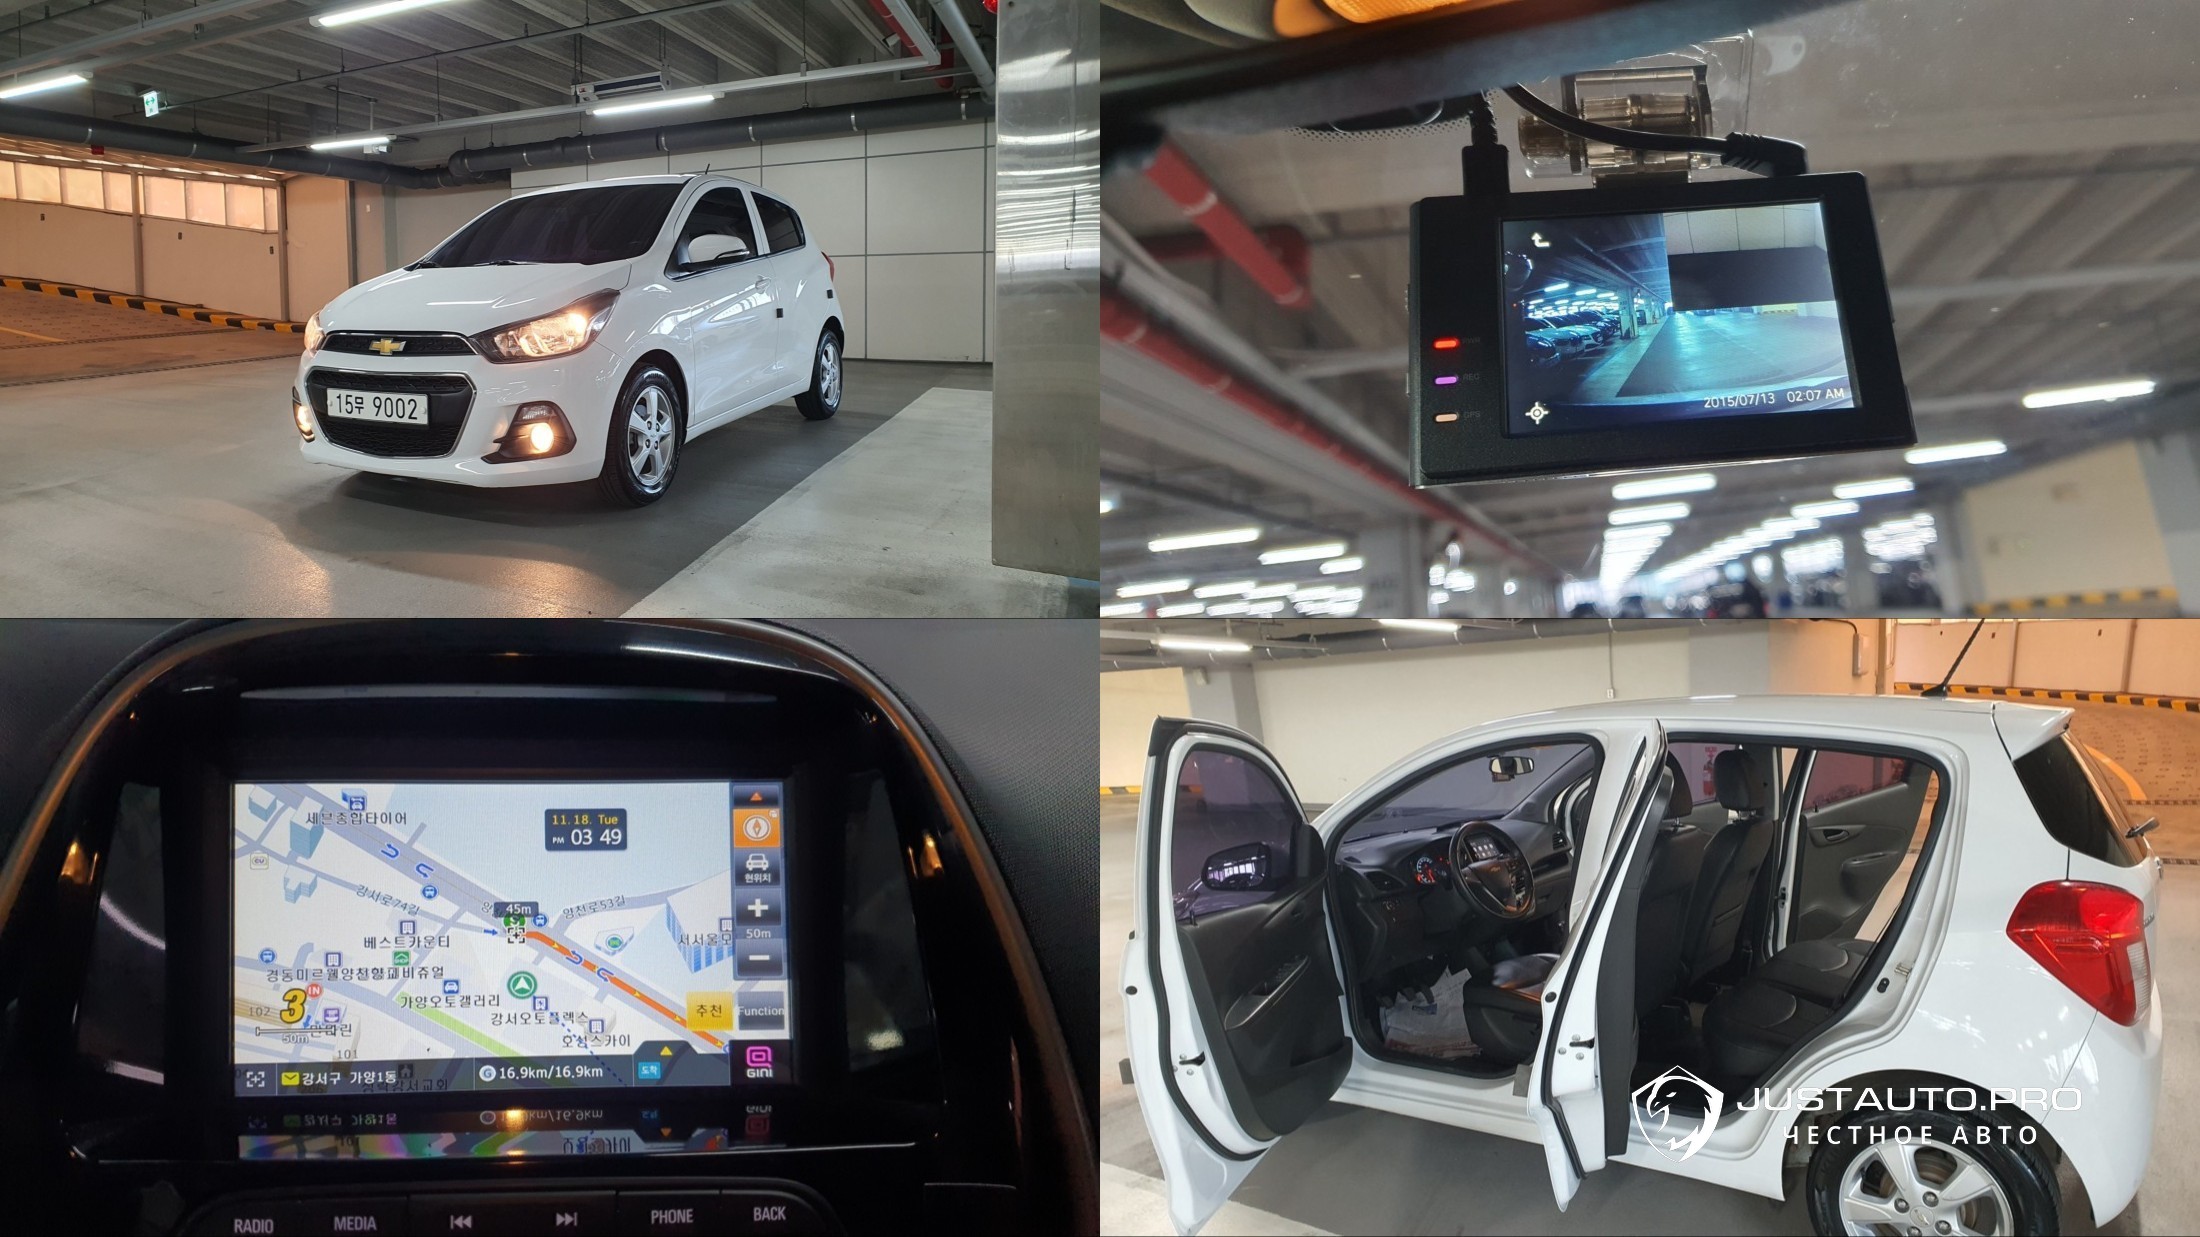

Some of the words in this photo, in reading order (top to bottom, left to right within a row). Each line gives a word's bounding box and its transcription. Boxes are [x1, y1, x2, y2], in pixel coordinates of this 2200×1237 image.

[1703, 393, 1776, 409] 2015/07/13
[1786, 390, 1821, 404] 02:07
[1825, 387, 1845, 400] AM
[373, 396, 418, 420] 9002
[598, 814, 618, 825] Tue
[570, 829, 593, 845] 03
[599, 829, 622, 845] 49
[744, 873, 771, 884] 현위치
[356, 884, 420, 916] 강서로74길
[562, 895, 626, 920] 양천로53길
[506, 903, 532, 915] 45m
[746, 928, 771, 939] 50m
[364, 936, 450, 949] 베스트카운티
[307, 985, 320, 996] IN
[280, 988, 307, 1024] 3
[401, 994, 501, 1009] 가양오토갤러리
[248, 1007, 271, 1017] 102
[696, 1003, 723, 1018] 추천
[739, 1006, 785, 1016] Function
[491, 1011, 589, 1026] 강서오토플렉스
[282, 1034, 309, 1044] 50m
[302, 1073, 341, 1085] 강서구
[350, 1071, 397, 1084] 가양1동
[640, 1065, 658, 1076] 도착
[650, 1209, 694, 1225] PHONE
[753, 1206, 786, 1221] BACK
[233, 1218, 274, 1234] RADIO
[334, 1216, 377, 1231] MEDIA
